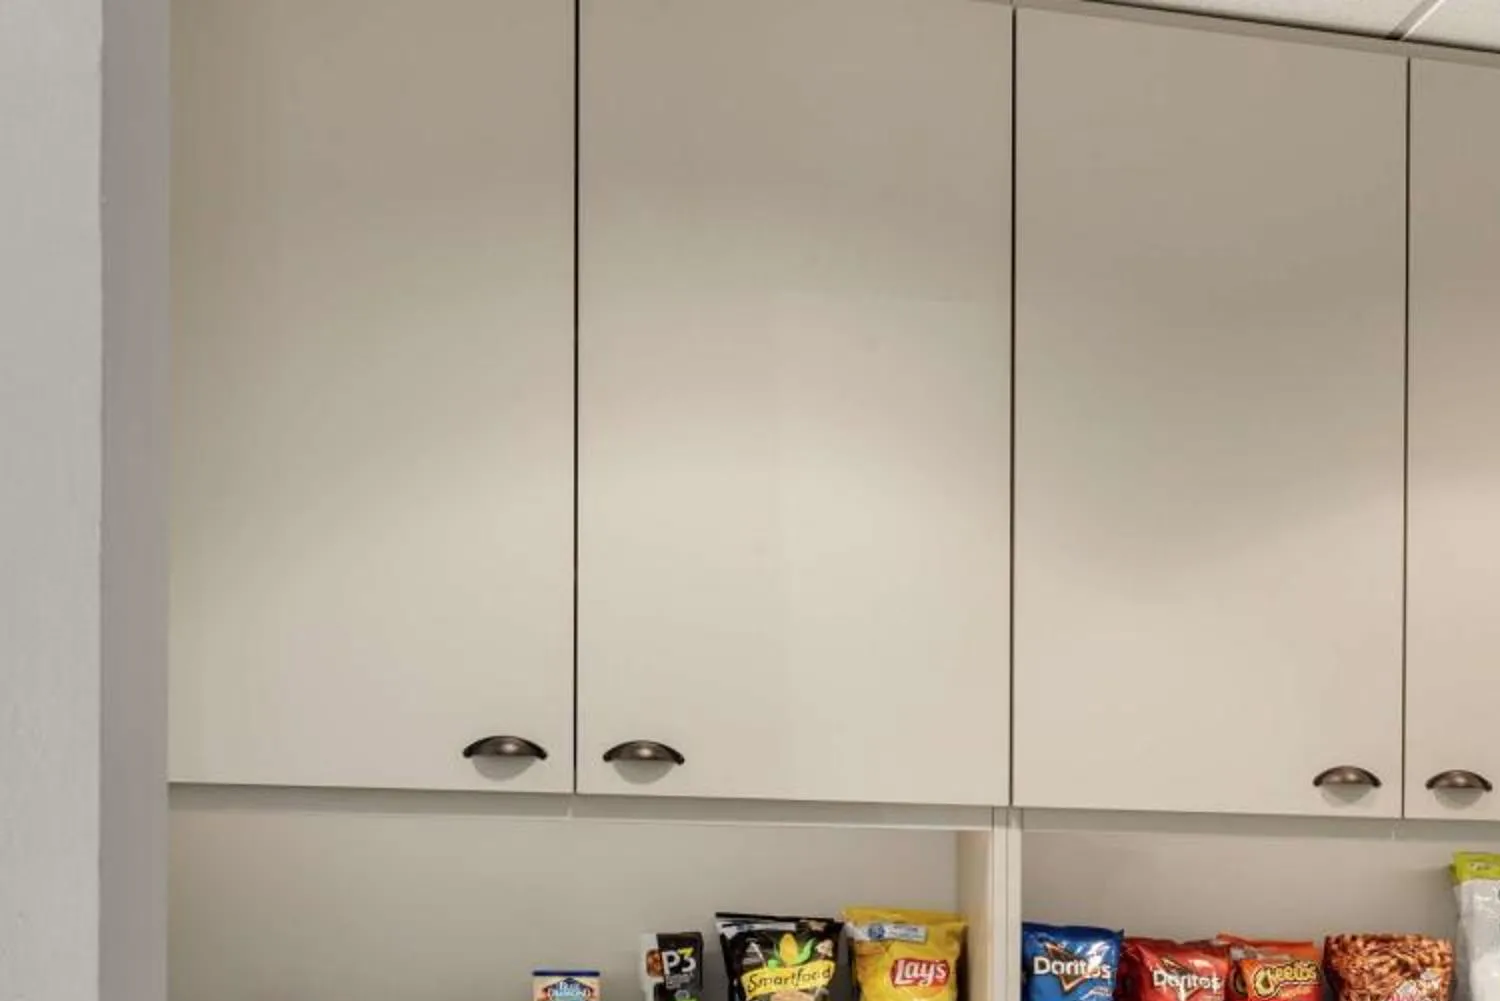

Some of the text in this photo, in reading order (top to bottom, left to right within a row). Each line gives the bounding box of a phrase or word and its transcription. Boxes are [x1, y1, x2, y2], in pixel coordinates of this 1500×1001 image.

[661, 947, 697, 975] P3
[1033, 956, 1113, 980] Doritos
[747, 966, 832, 995] Smartfood
[1153, 969, 1221, 992] Doritos
[1254, 960, 1318, 997] Cheetos
